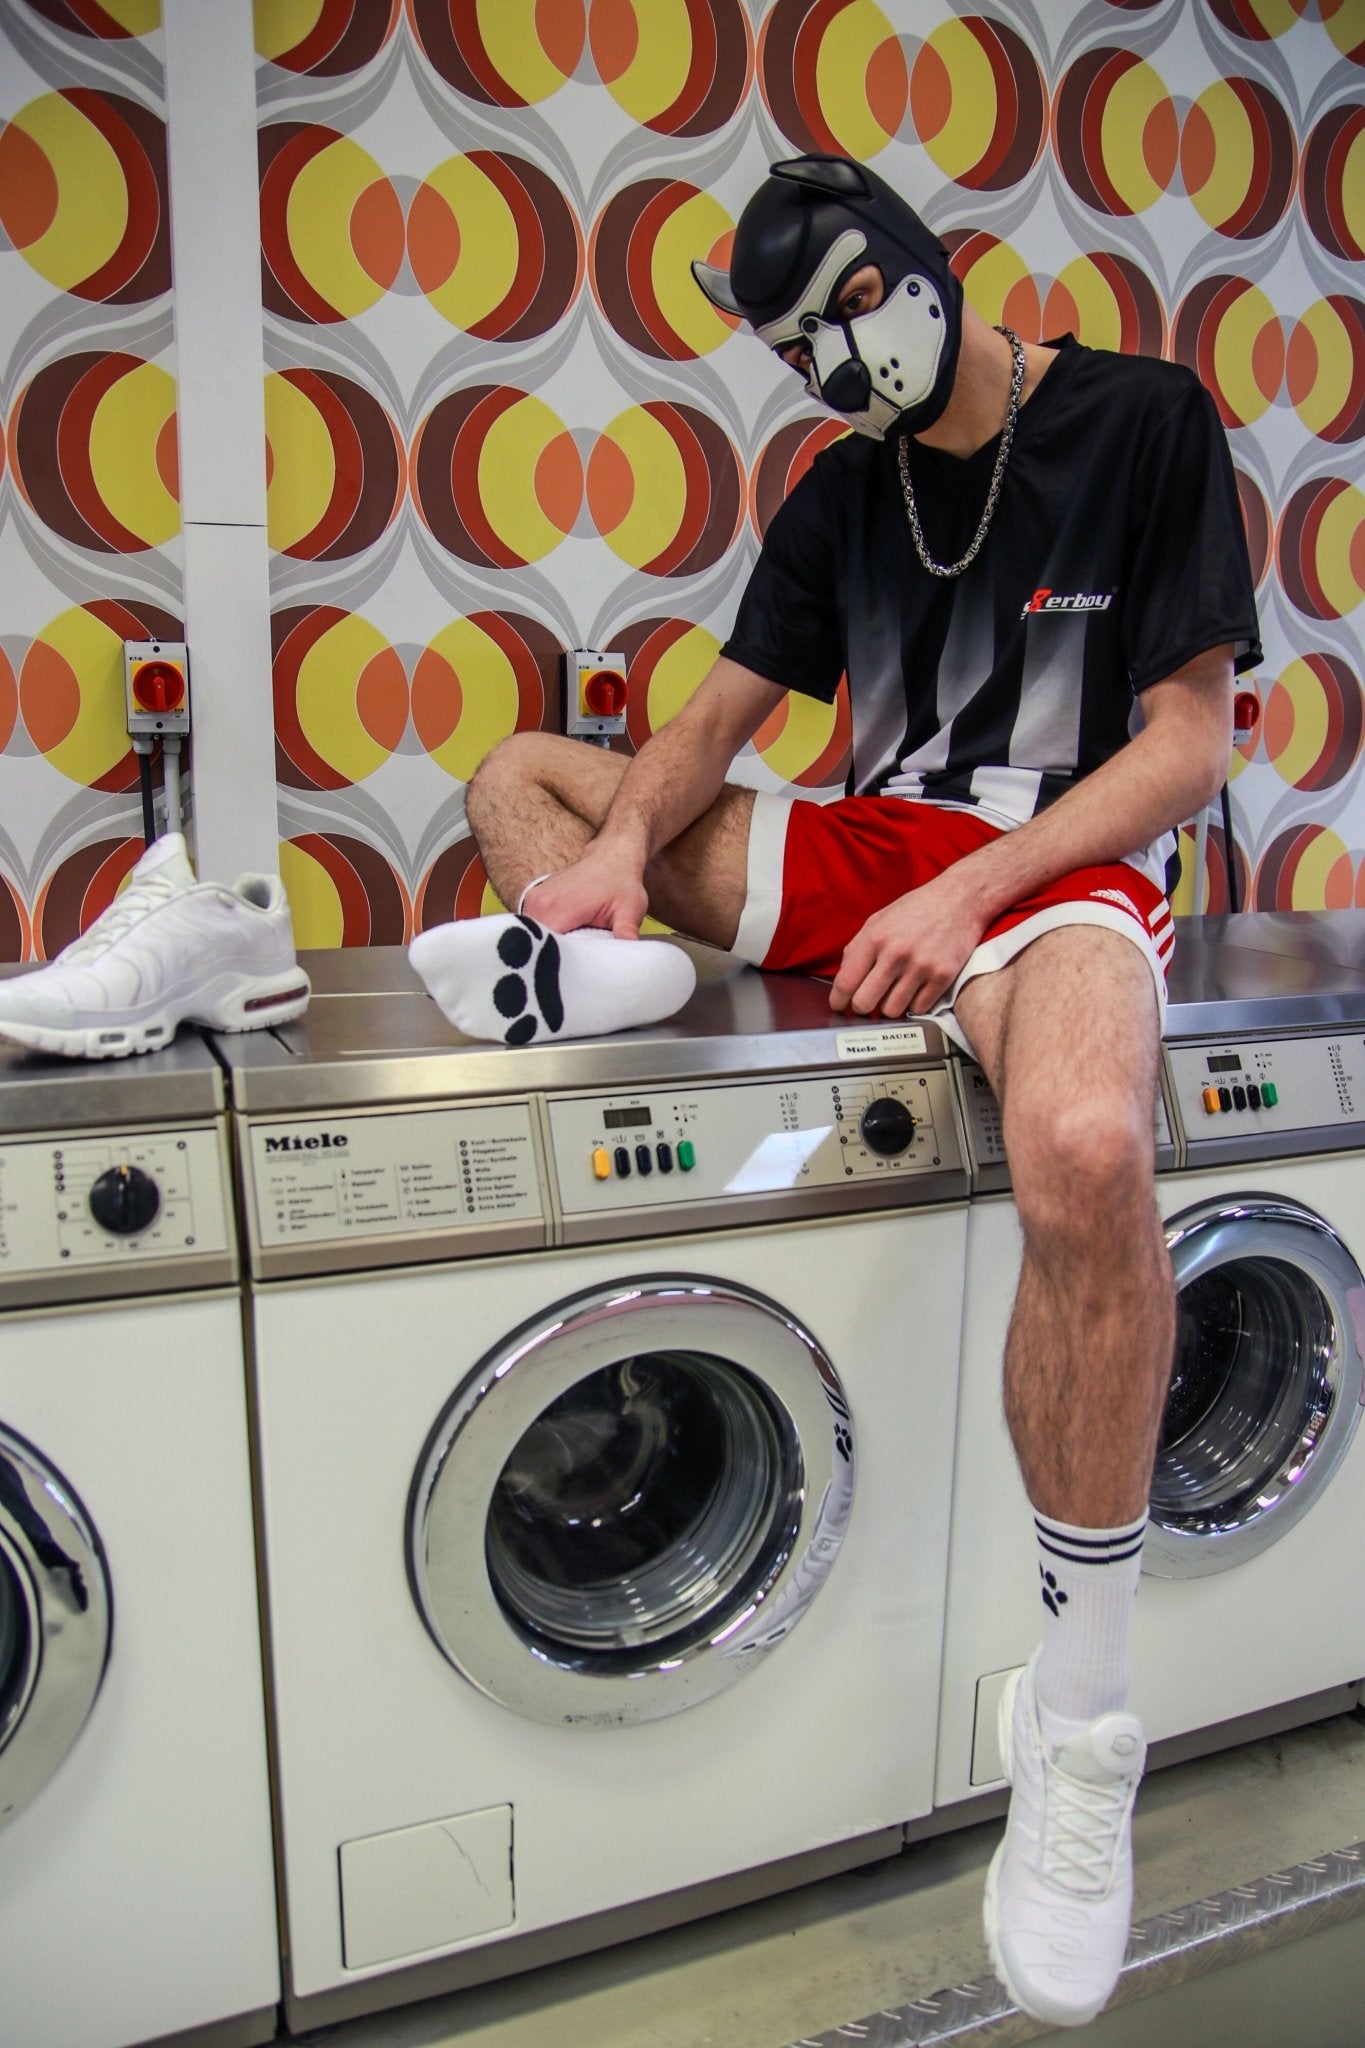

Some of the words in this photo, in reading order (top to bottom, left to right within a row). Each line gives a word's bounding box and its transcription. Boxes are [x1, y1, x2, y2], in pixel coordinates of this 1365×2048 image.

[881, 1032, 917, 1040] BAUER
[846, 1045, 877, 1054] Miele
[265, 1133, 348, 1152] Miele
